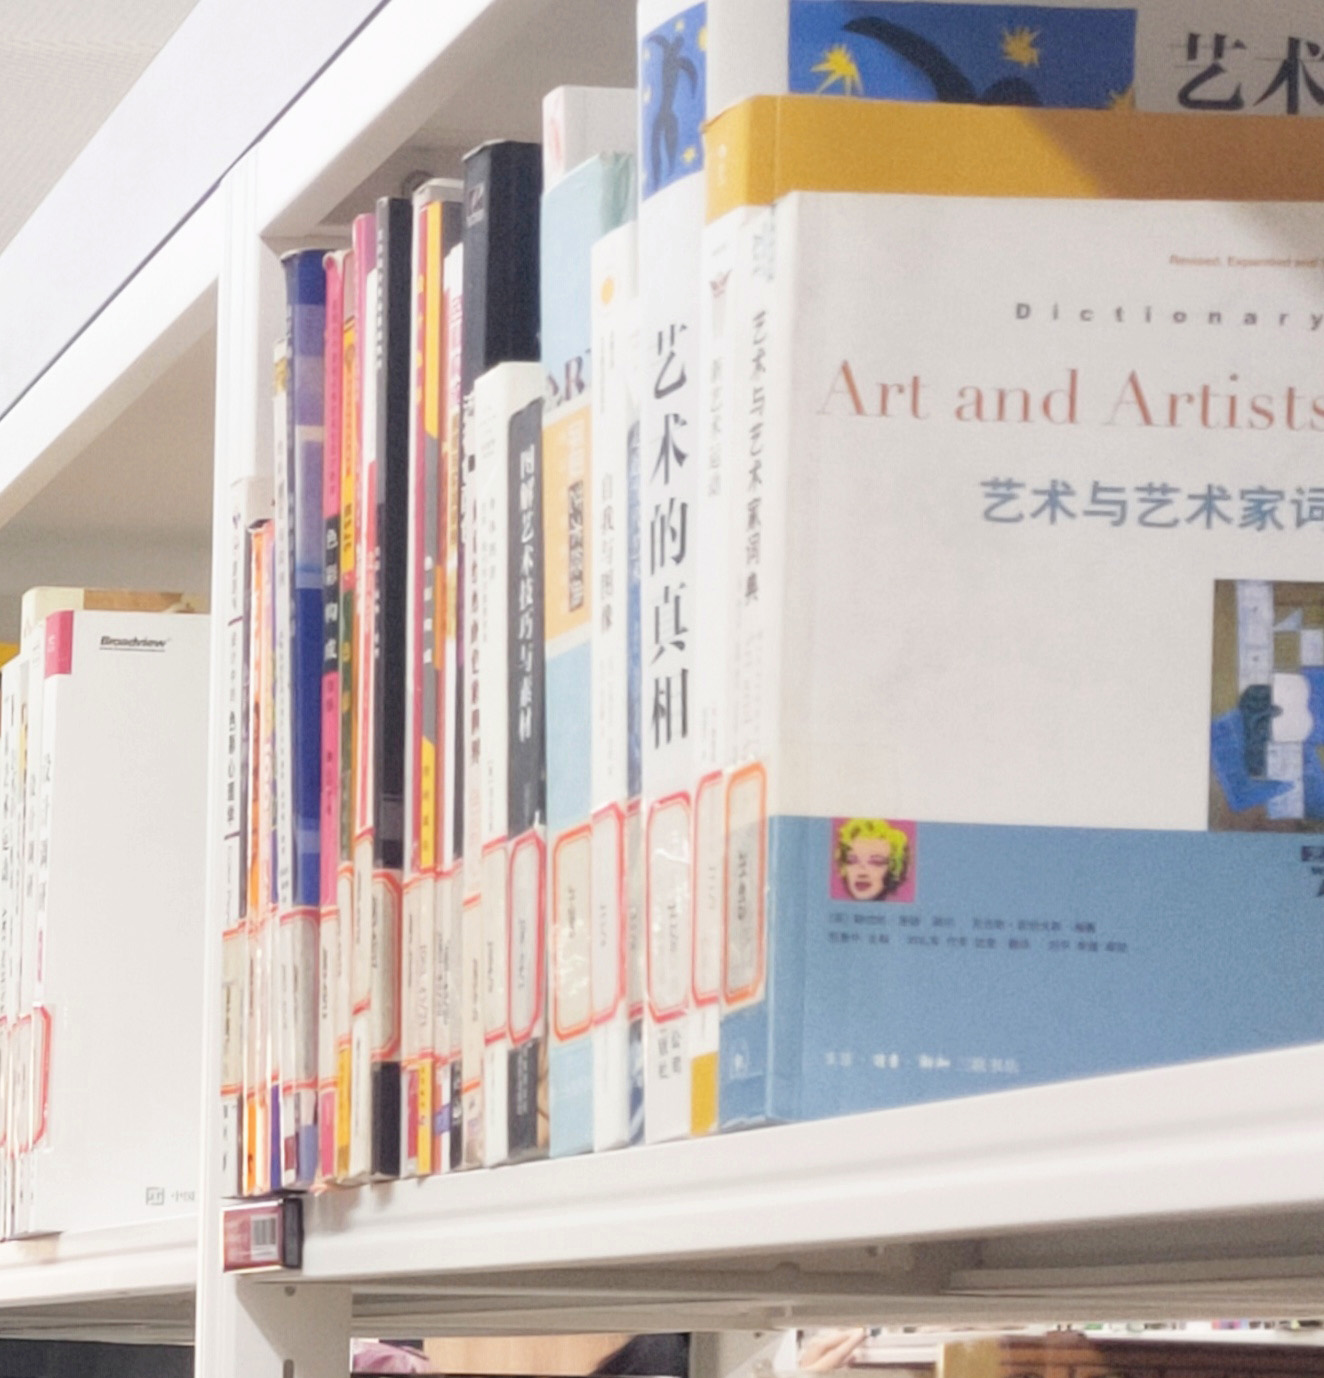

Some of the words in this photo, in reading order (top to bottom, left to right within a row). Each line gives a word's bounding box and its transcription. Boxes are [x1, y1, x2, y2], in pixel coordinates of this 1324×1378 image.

[816, 358, 929, 421] Art
[954, 368, 1080, 425] and
[1103, 370, 1324, 432] Artists
[648, 322, 689, 750] 艺术的真相
